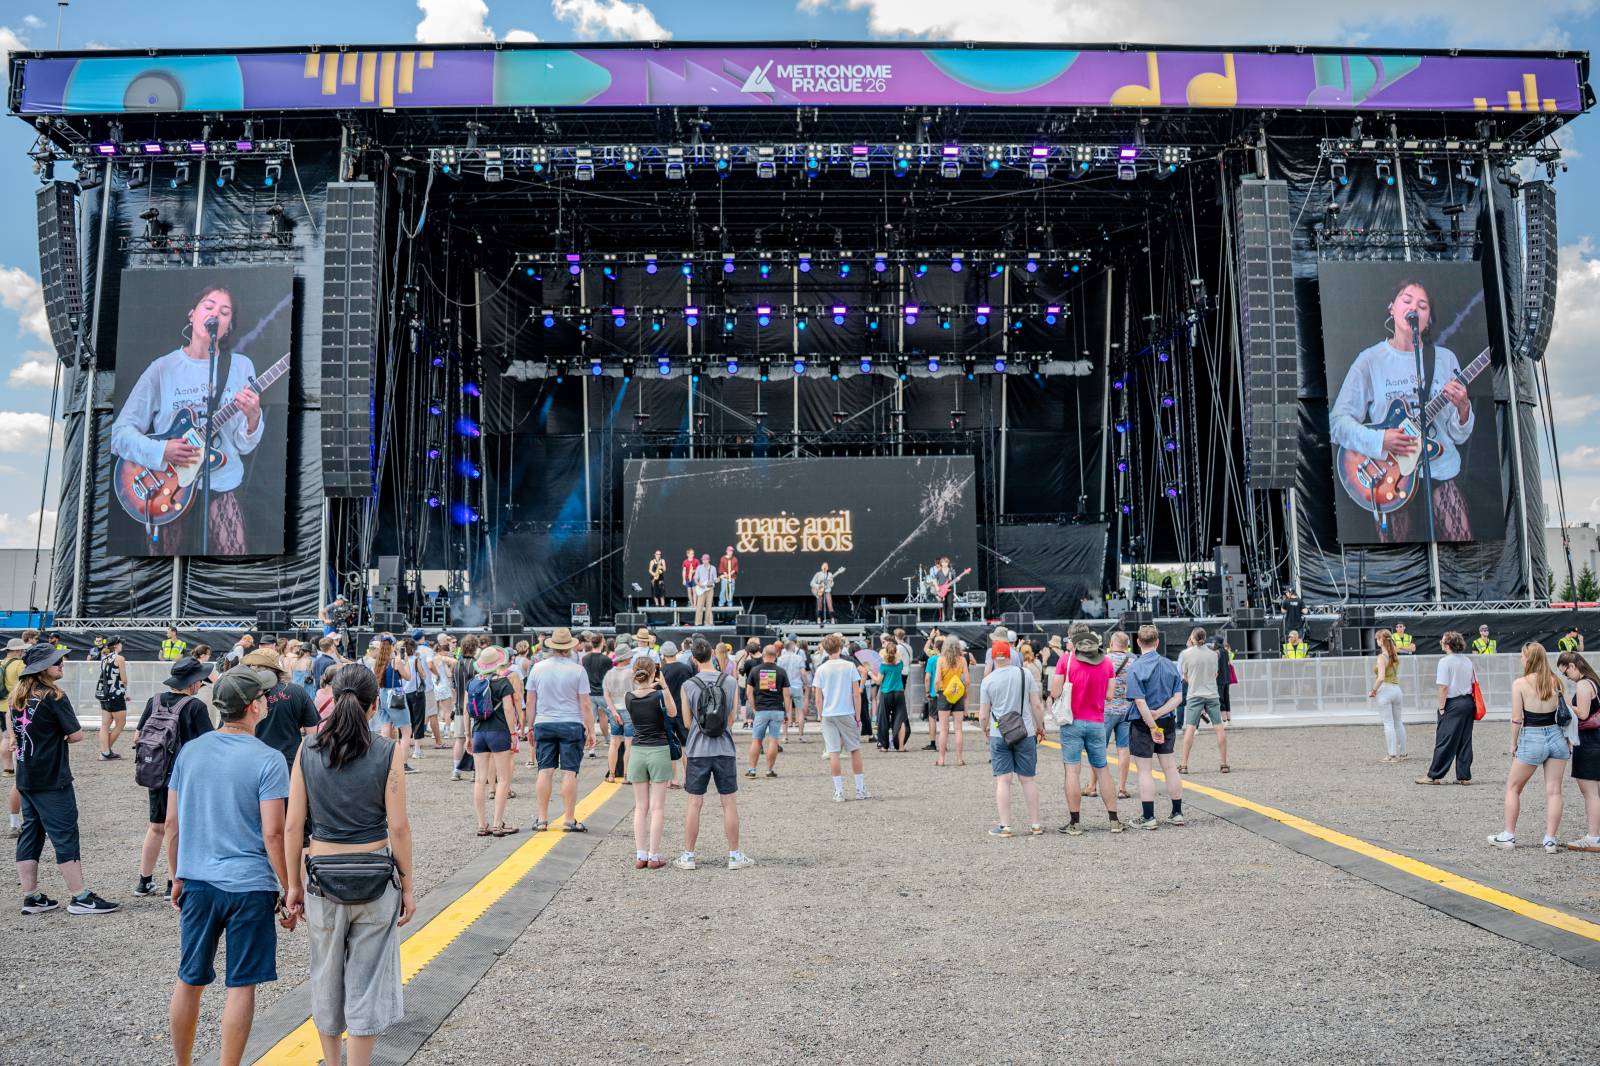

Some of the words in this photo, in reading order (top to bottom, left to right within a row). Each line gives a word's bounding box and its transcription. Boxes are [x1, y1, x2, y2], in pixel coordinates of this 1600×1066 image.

[777, 64, 892, 79] METRONOME
[791, 78, 863, 93] PRAGUE
[735, 510, 800, 535] marie
[803, 510, 853, 537] april
[735, 531, 760, 553] &
[762, 530, 798, 553] the
[800, 529, 854, 552] fools
